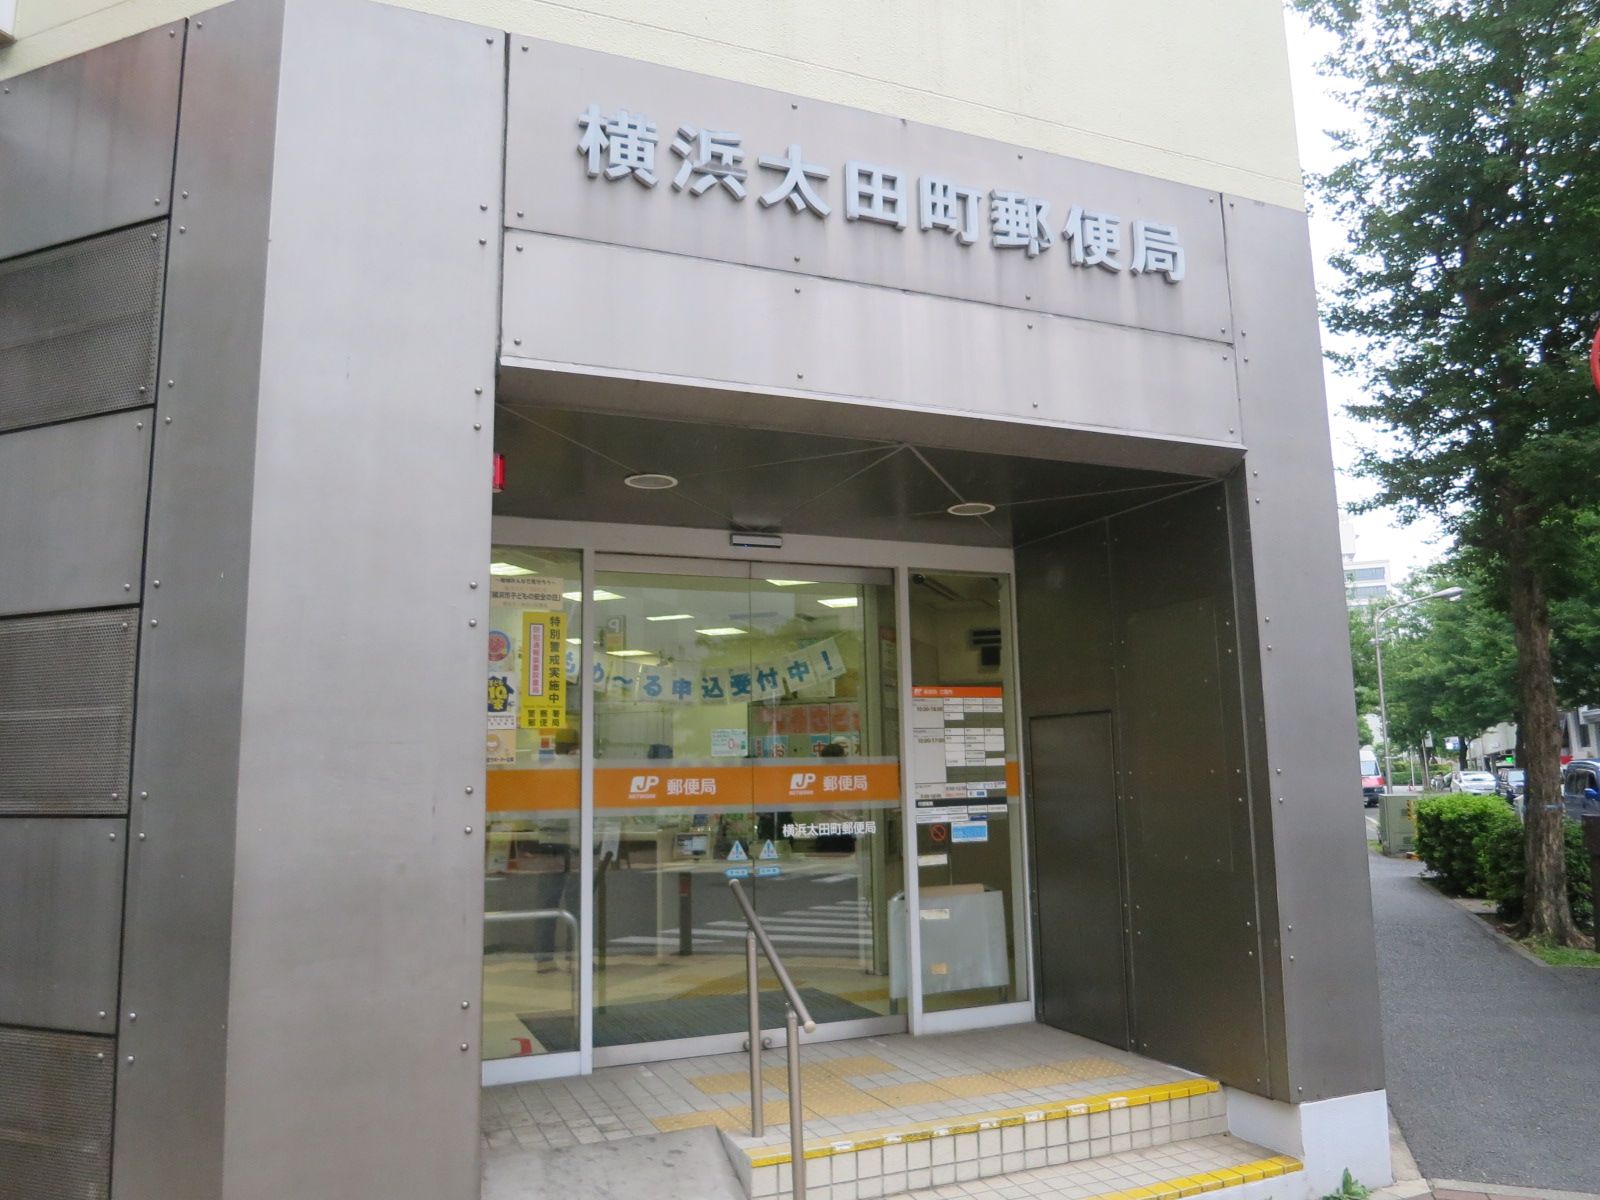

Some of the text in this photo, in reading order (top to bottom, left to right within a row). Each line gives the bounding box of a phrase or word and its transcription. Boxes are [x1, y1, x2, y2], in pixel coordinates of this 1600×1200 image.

[578, 104, 1187, 284] 横浜太田町郵便局
[549, 615, 561, 703] 特別警戒実施中
[630, 775, 717, 796] JP 郵便局
[790, 773, 868, 792] JP 郵便局
[782, 821, 876, 838] 横浜太田町郵便局
